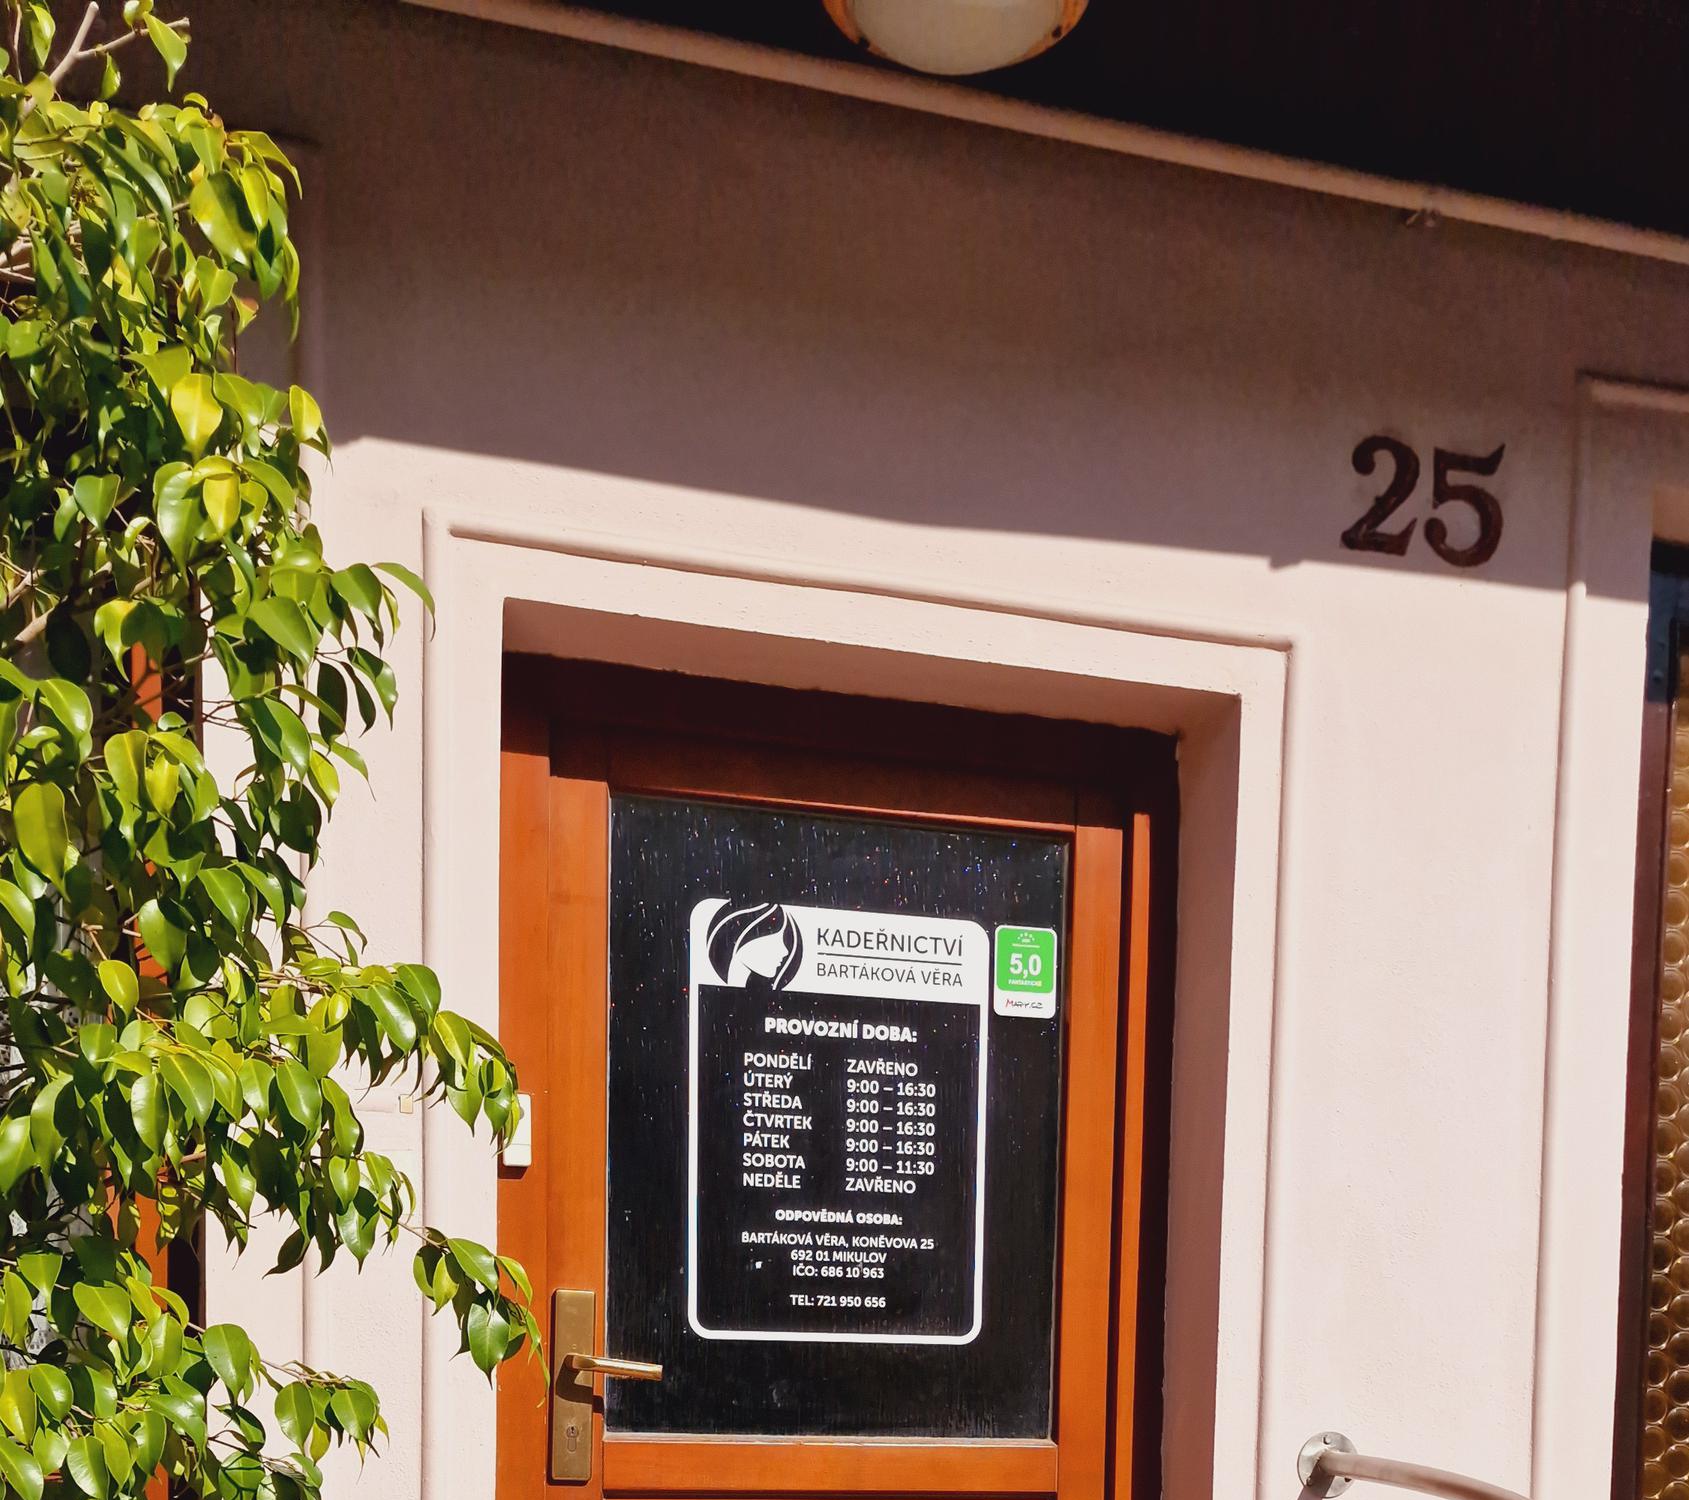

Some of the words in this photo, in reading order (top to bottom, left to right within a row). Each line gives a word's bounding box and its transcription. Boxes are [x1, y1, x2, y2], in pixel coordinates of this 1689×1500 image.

[1340, 435, 1506, 568] 25
[817, 927, 963, 957] KADEŘNICTVÍ
[816, 962, 916, 984] BARTÁKOVÁ
[921, 968, 963, 987] VĚRA
[1009, 952, 1042, 979] 5,0
[764, 1017, 859, 1039] PROVOZNÍ
[862, 1024, 918, 1043] DOBA:
[743, 1052, 812, 1070] PONDĚLÍ
[846, 1058, 918, 1077] ZAVŘENO
[743, 1070, 793, 1089] ÚTERÝ
[847, 1079, 880, 1094] 9:00
[897, 1083, 936, 1097] 16:30
[743, 1091, 803, 1109] STŘEDA
[846, 1099, 880, 1113] 9:00
[896, 1102, 936, 1117] 16:30
[742, 1110, 813, 1130] ČTVRTEK
[846, 1119, 879, 1133] 9:00
[896, 1122, 935, 1136] 16:30
[743, 1131, 790, 1148] PÁTEK
[846, 1138, 879, 1153] 9:00
[895, 1142, 935, 1156] 16:30
[742, 1153, 806, 1169] SOBOTA
[846, 1158, 878, 1173] 9:00
[896, 1161, 935, 1175] 11:30
[742, 1171, 801, 1189] NEDĚLE
[845, 1175, 916, 1194] ZAVŘENO
[775, 1209, 854, 1224] ODPOVĚDNÁ
[856, 1213, 903, 1225] OSOBA:
[741, 1230, 813, 1246] BARTÁKOVÁ
[816, 1233, 848, 1248] VĚRA,
[852, 1235, 918, 1249] KONĚVOVA
[920, 1238, 935, 1250] 25
[790, 1249, 813, 1261] 692
[815, 1250, 830, 1262] 01
[832, 1251, 887, 1263] MIKULOV
[792, 1262, 818, 1277] IČO:
[821, 1266, 843, 1277] 686
[845, 1266, 860, 1278] 10
[863, 1267, 884, 1278] 963
[789, 1294, 815, 1306] TEL:
[816, 1295, 837, 1307] 721
[839, 1296, 862, 1307] 950
[864, 1297, 886, 1308] 656
